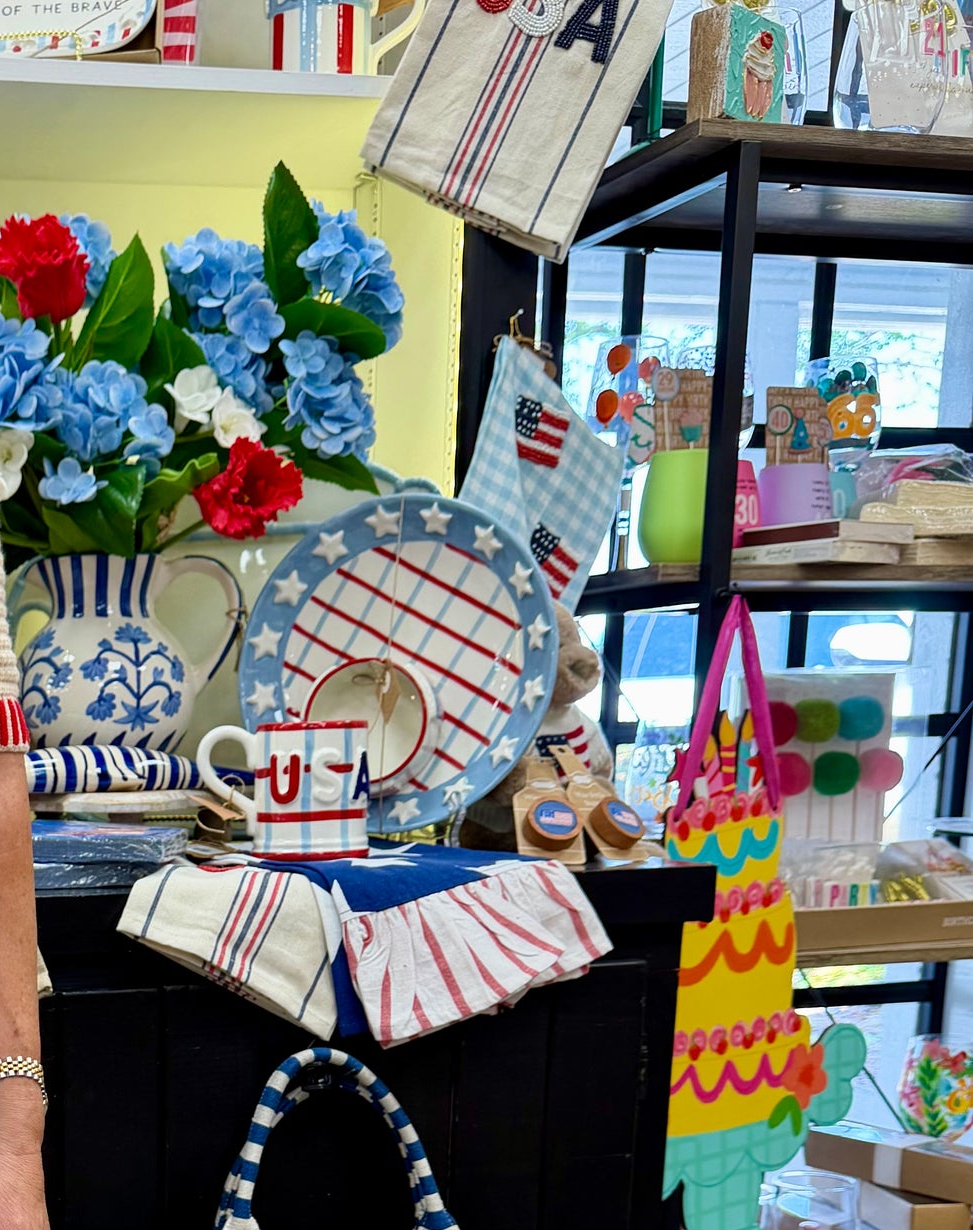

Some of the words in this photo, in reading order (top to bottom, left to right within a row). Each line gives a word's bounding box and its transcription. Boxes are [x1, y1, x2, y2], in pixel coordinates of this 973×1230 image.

[1, 5, 23, 17] OF
[32, 3, 62, 14] THE
[71, 0, 122, 13] BRAVE
[734, 493, 759, 526] 30
[269, 747, 370, 804] USA
